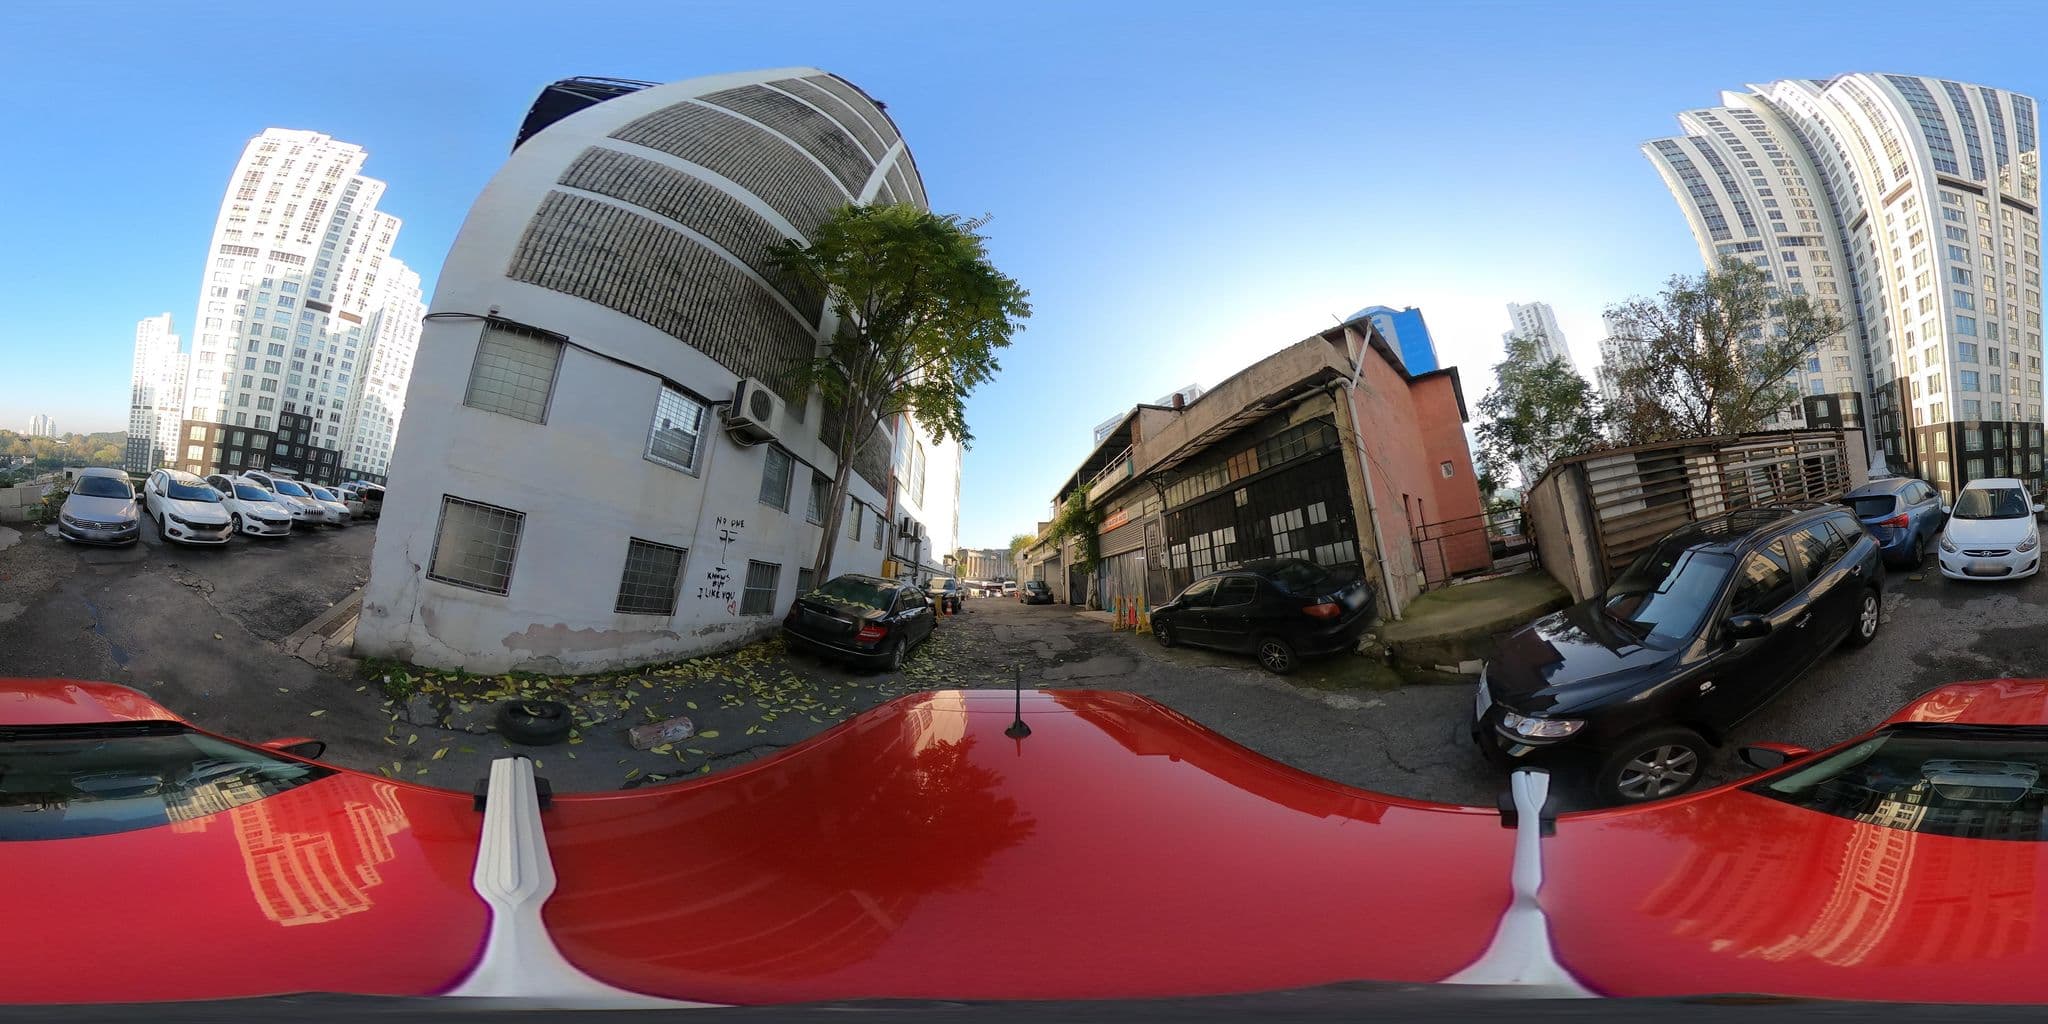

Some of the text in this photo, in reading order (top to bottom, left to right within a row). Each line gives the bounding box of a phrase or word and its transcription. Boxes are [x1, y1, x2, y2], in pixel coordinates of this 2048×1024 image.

[707, 572, 731, 581] KNOWS
[705, 588, 720, 599] LIKE
[722, 591, 735, 602] YOU
